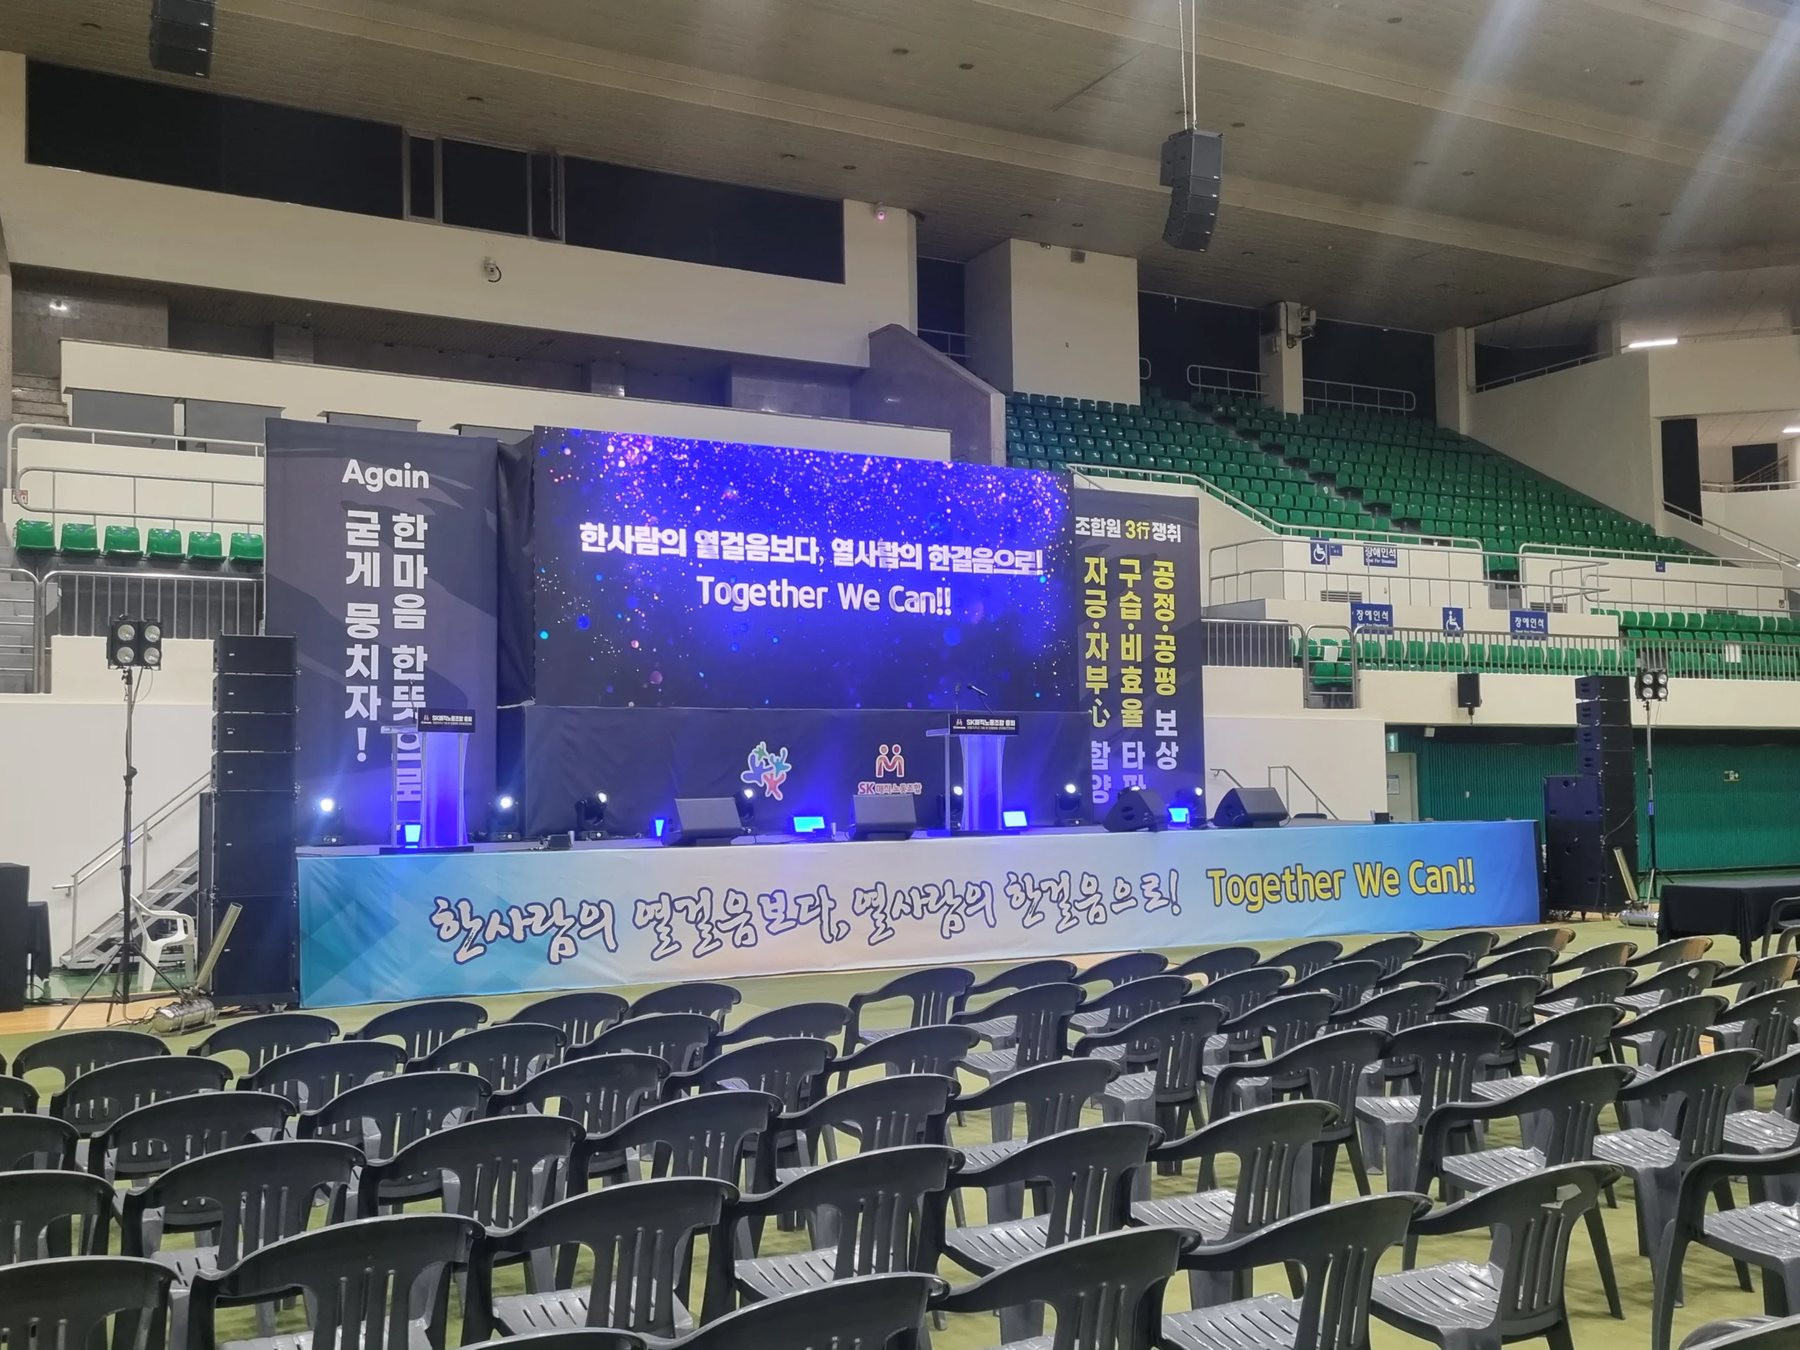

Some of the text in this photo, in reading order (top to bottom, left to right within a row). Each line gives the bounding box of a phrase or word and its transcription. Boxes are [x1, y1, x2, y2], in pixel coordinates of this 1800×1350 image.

[341, 459, 430, 492] Again
[579, 522, 1044, 576] 한사람의 열걸음보다, 열사람의 한걸음으로!
[1075, 516, 1121, 538] 조합원
[1365, 546, 1396, 559] 장애인석
[392, 513, 428, 630] 한마음
[696, 575, 952, 616] Together We Can!!
[345, 509, 381, 762] 굳게 뭉치자!
[1356, 609, 1389, 622] 장애인석
[1513, 616, 1544, 629] 장애인석
[1155, 709, 1179, 770] 보상
[1091, 740, 1112, 804] 함양
[1206, 857, 1476, 913] Together We Can!!
[429, 868, 1182, 965] 한사람의 열걸음보다, 열사람의 한걸음으로!
